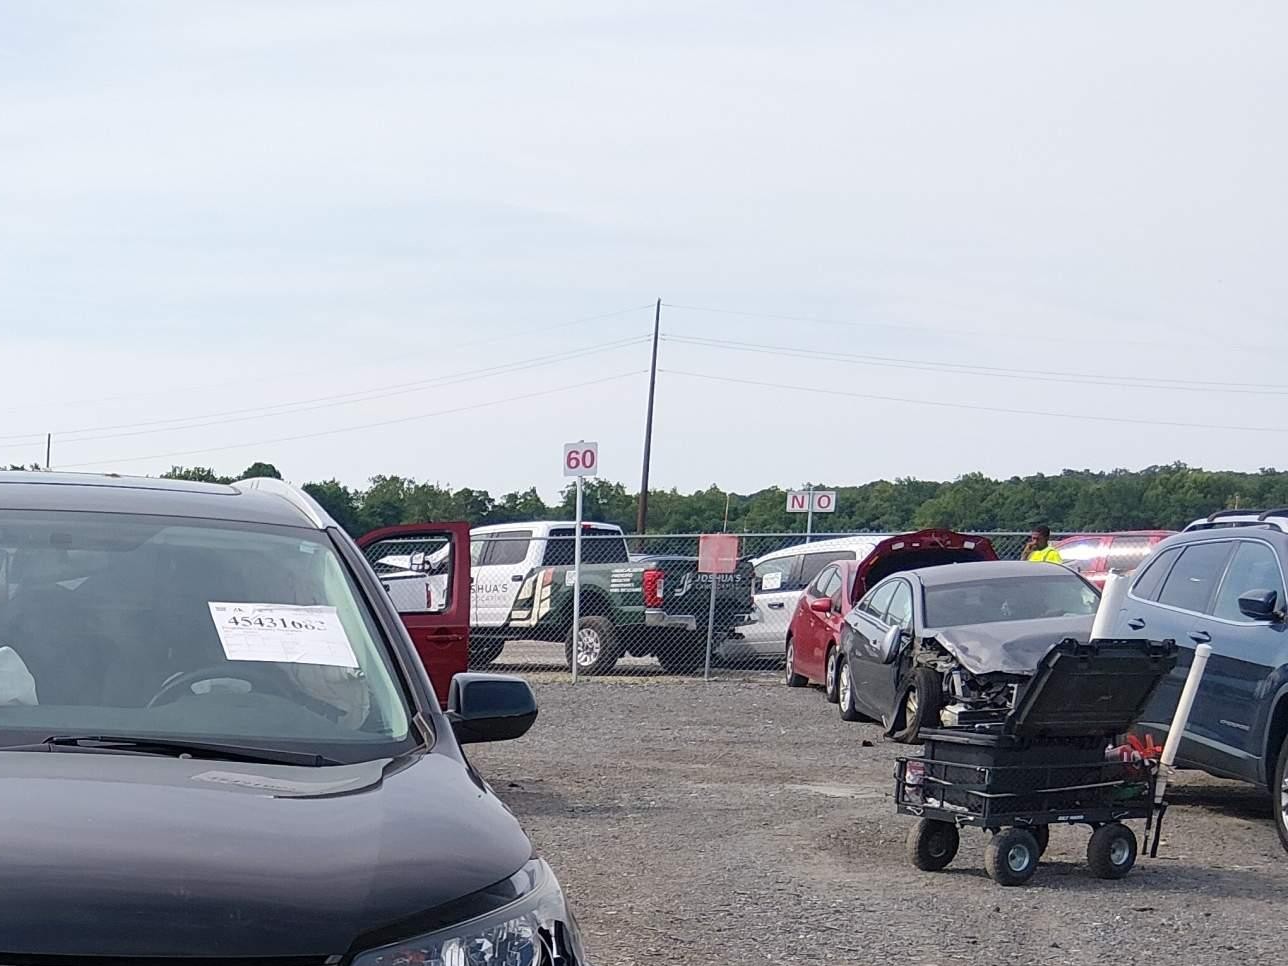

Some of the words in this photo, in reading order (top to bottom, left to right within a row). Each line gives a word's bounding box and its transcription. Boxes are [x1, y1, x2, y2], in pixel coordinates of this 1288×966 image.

[567, 449, 595, 469] 60
[791, 495, 805, 509] N
[817, 494, 831, 509] O
[470, 583, 508, 594] SHUA'S
